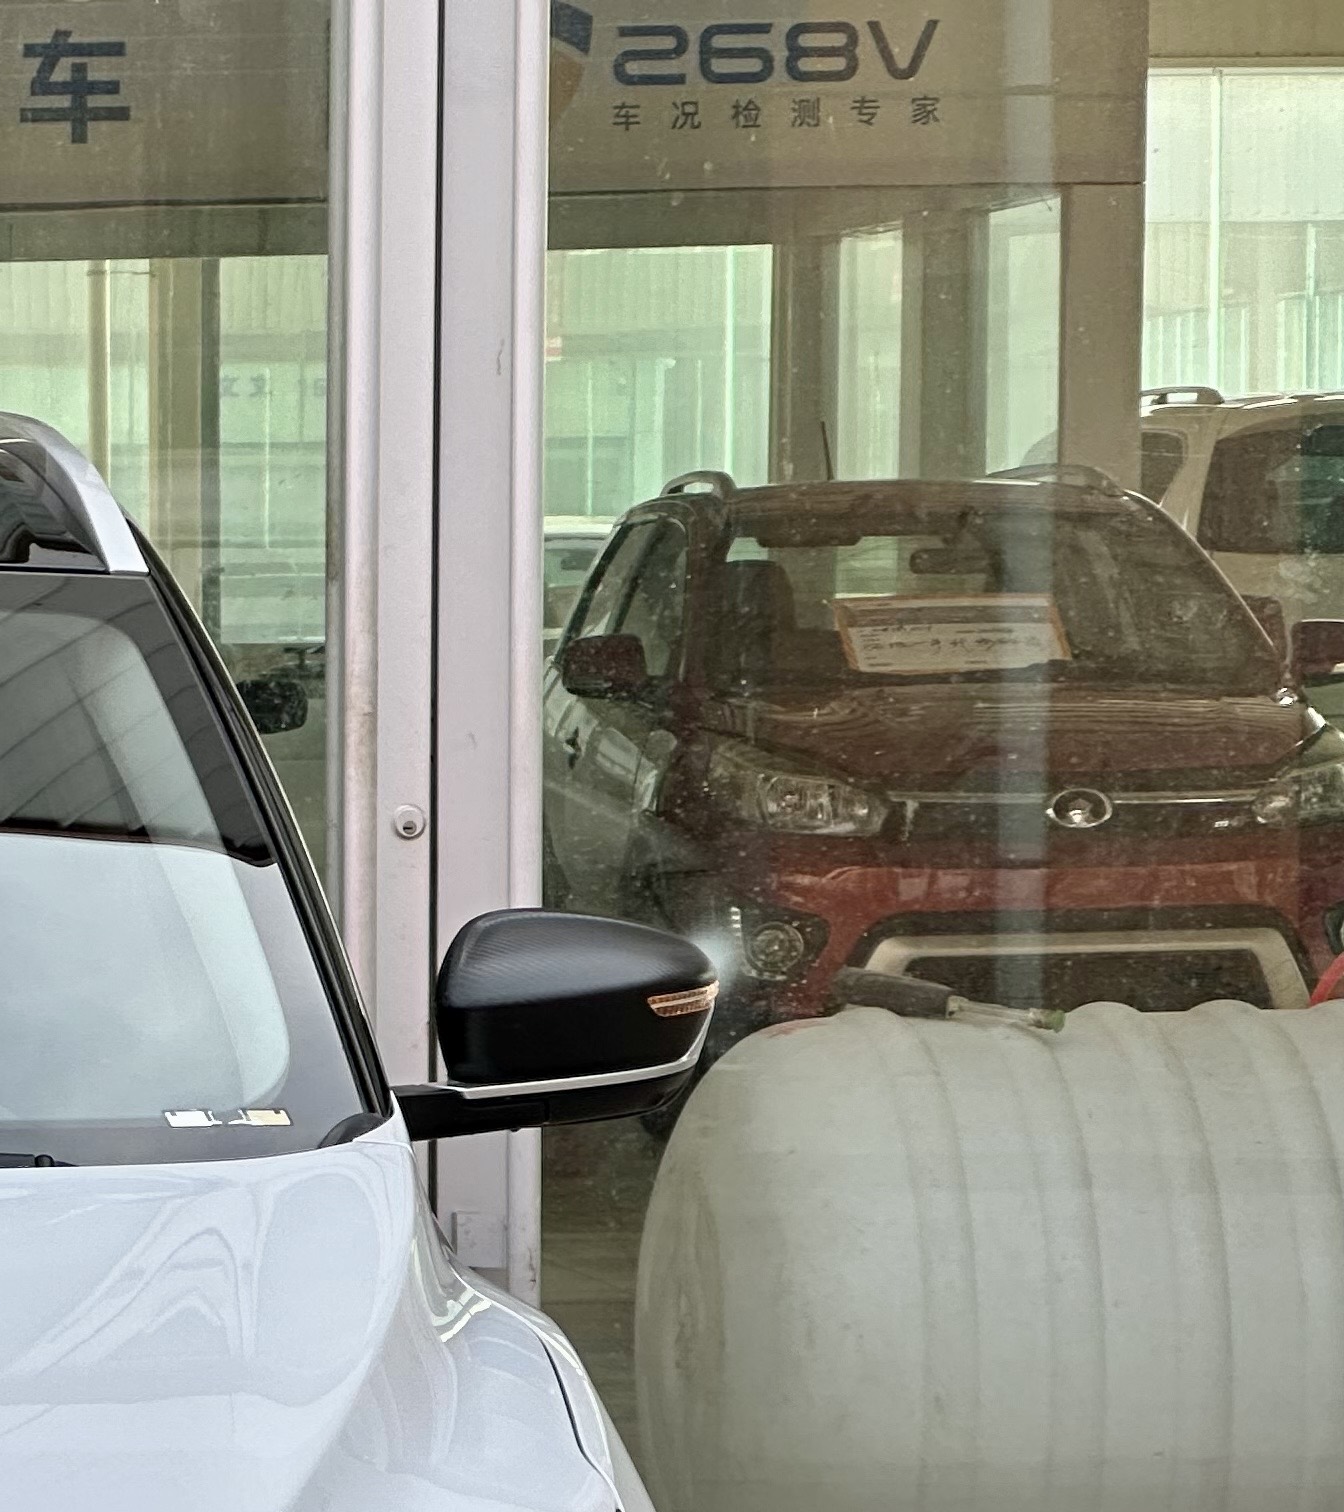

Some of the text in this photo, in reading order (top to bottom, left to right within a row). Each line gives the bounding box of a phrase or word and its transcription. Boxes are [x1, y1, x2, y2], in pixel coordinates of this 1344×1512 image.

[612, 18, 941, 86] 268V
[611, 95, 942, 133] 车况检测专家
